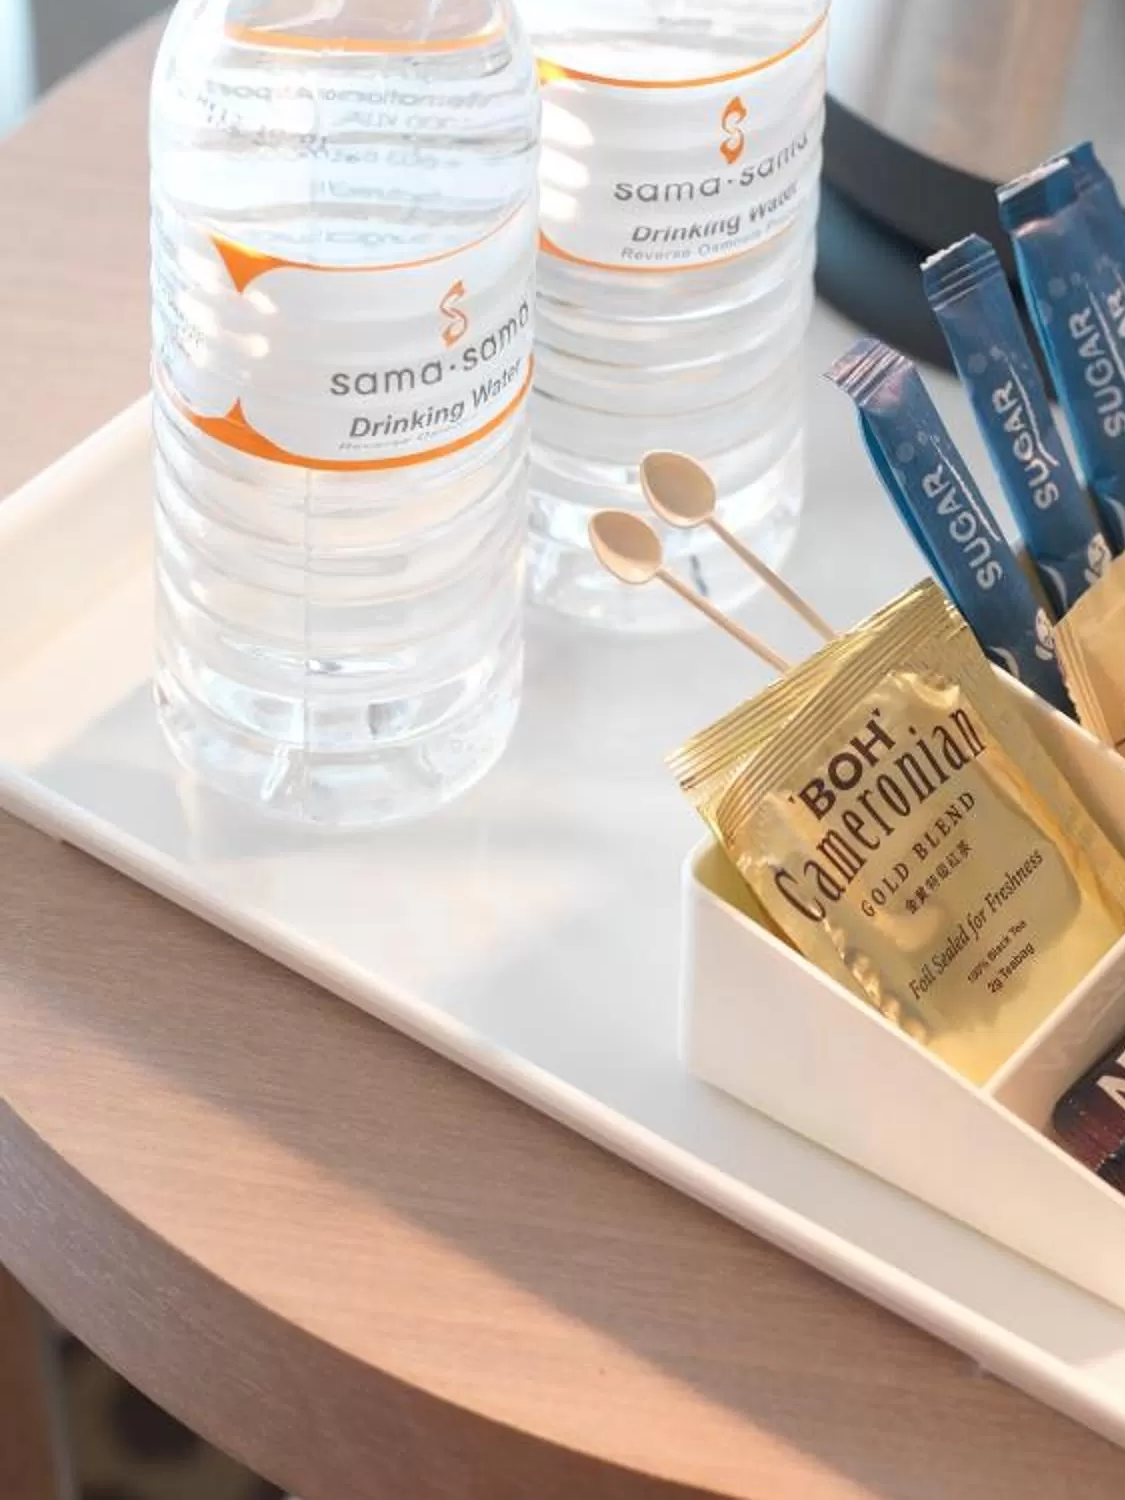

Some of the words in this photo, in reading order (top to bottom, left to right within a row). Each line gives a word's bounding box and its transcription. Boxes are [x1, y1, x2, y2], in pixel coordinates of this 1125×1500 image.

[632, 214, 741, 244] Drinking
[748, 179, 800, 225] Water
[349, 399, 466, 439] Drinking
[472, 358, 522, 409] Water
[992, 378, 1060, 511] SUGAR
[921, 464, 1003, 591] SUGAR
[774, 706, 986, 924] Cameronian
[861, 862, 910, 917] GOLD
[912, 792, 976, 861] BLEND
[908, 963, 937, 1000] Foil
[931, 924, 971, 975] Sealed
[966, 910, 988, 942] for
[984, 849, 1044, 913] Freshness
[1000, 941, 1036, 980] Teabag
